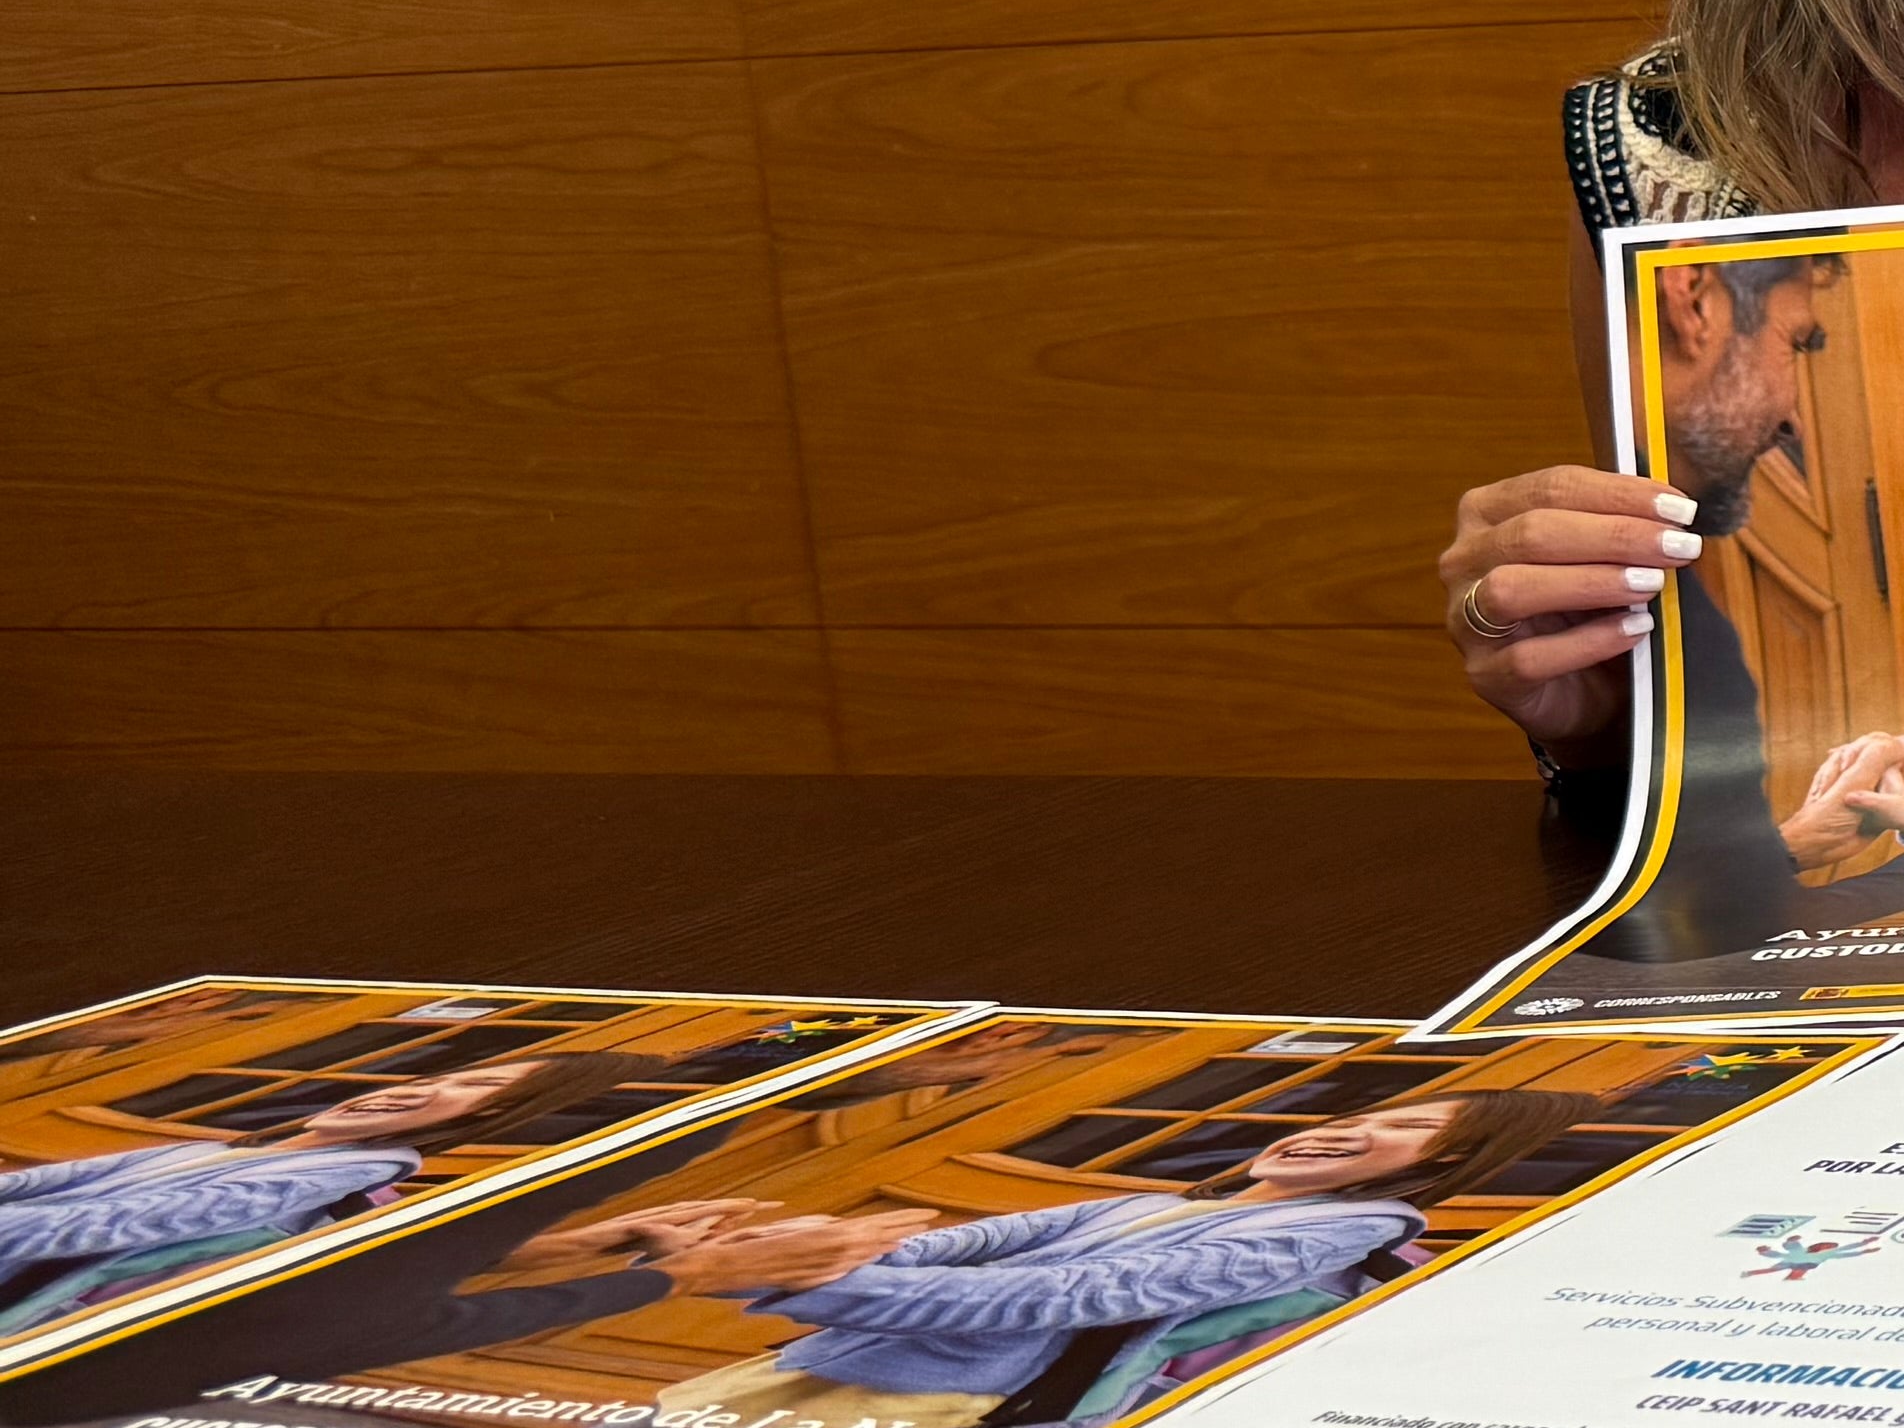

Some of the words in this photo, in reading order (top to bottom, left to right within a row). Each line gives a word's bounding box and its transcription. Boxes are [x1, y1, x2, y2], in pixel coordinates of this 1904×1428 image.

[1593, 990, 1781, 1008] CORRESPONSABLES
[1801, 1158, 1877, 1174] POR
[201, 1375, 655, 1424] Ayuntamiento
[1634, 1393, 1706, 1411] CEIP
[1698, 1397, 1788, 1417] SANT
[1779, 1401, 1893, 1422] RAFAEL
